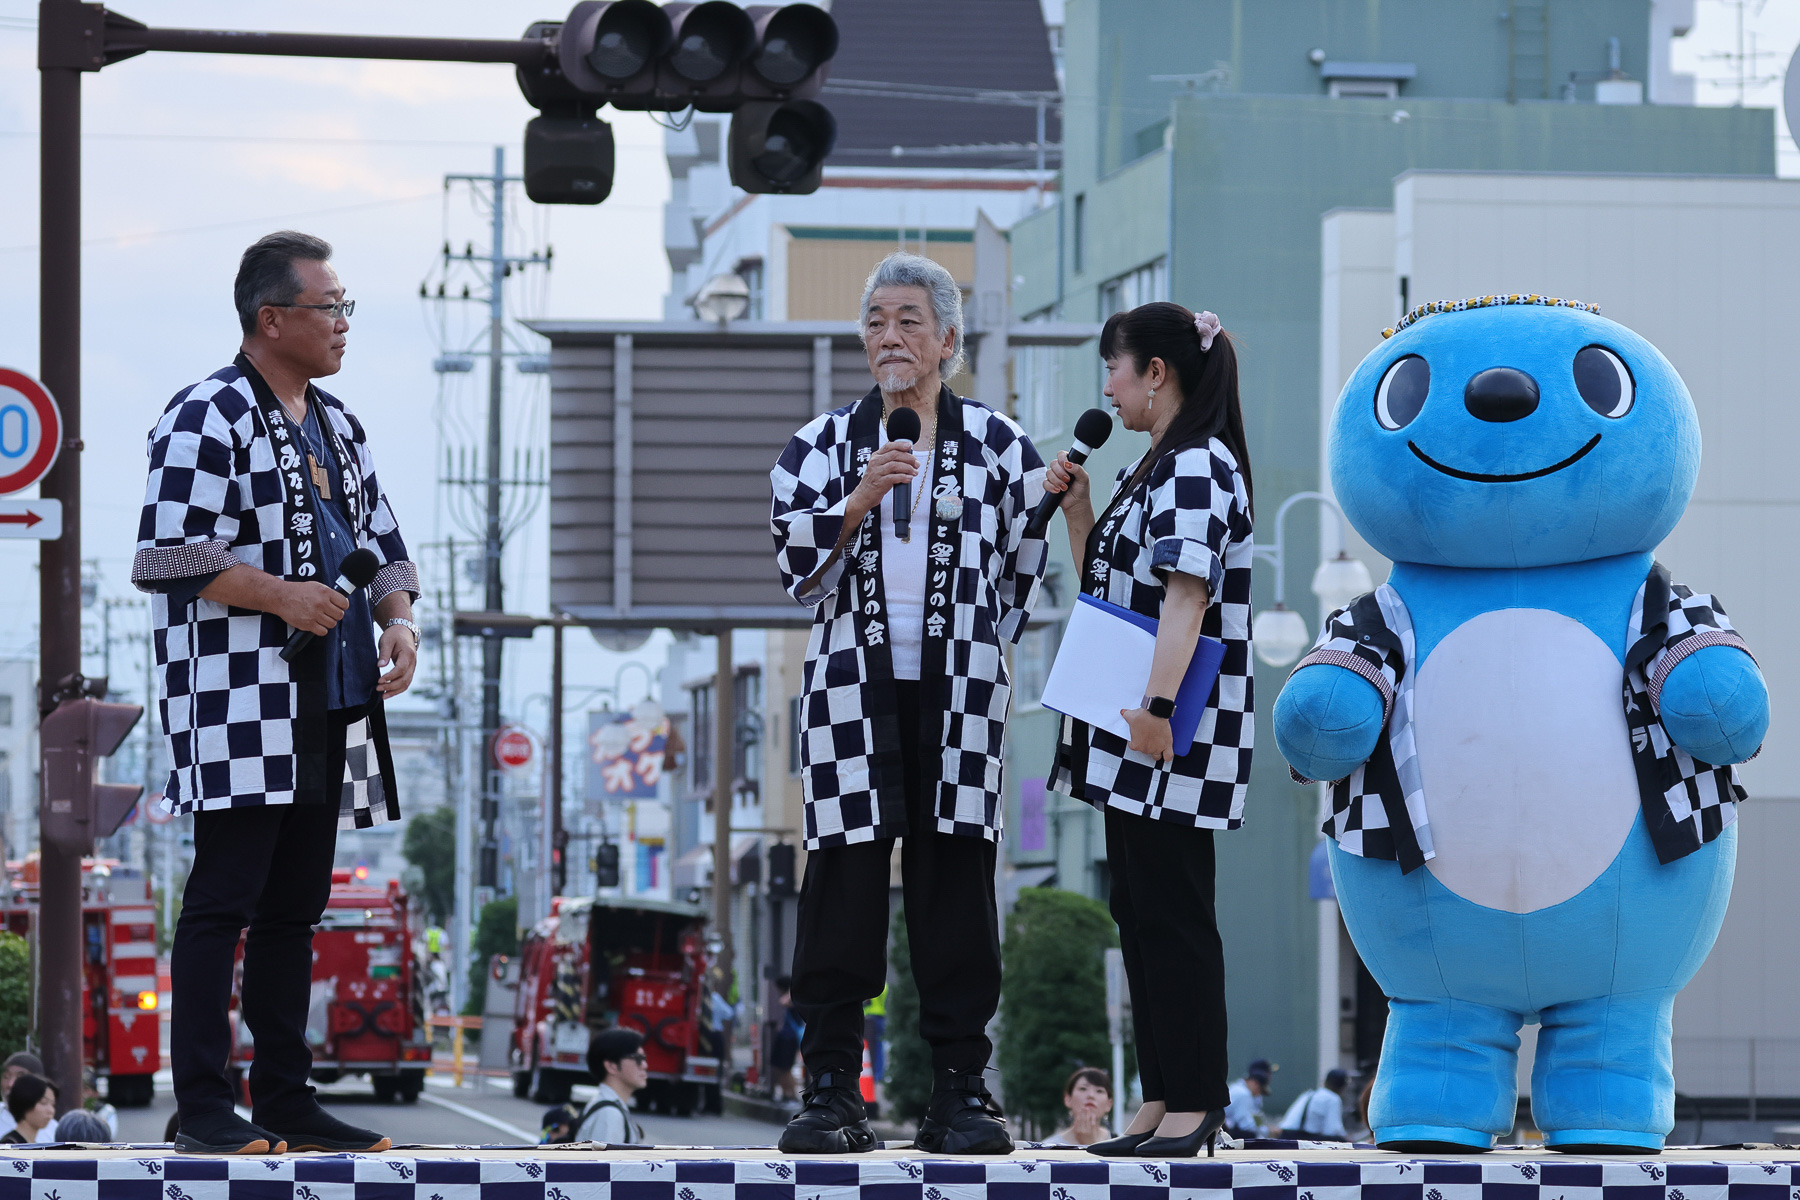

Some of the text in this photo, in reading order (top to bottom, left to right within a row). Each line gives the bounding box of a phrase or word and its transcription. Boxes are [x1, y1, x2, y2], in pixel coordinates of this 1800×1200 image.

[927, 440, 961, 638] 清水みと祭りの会
